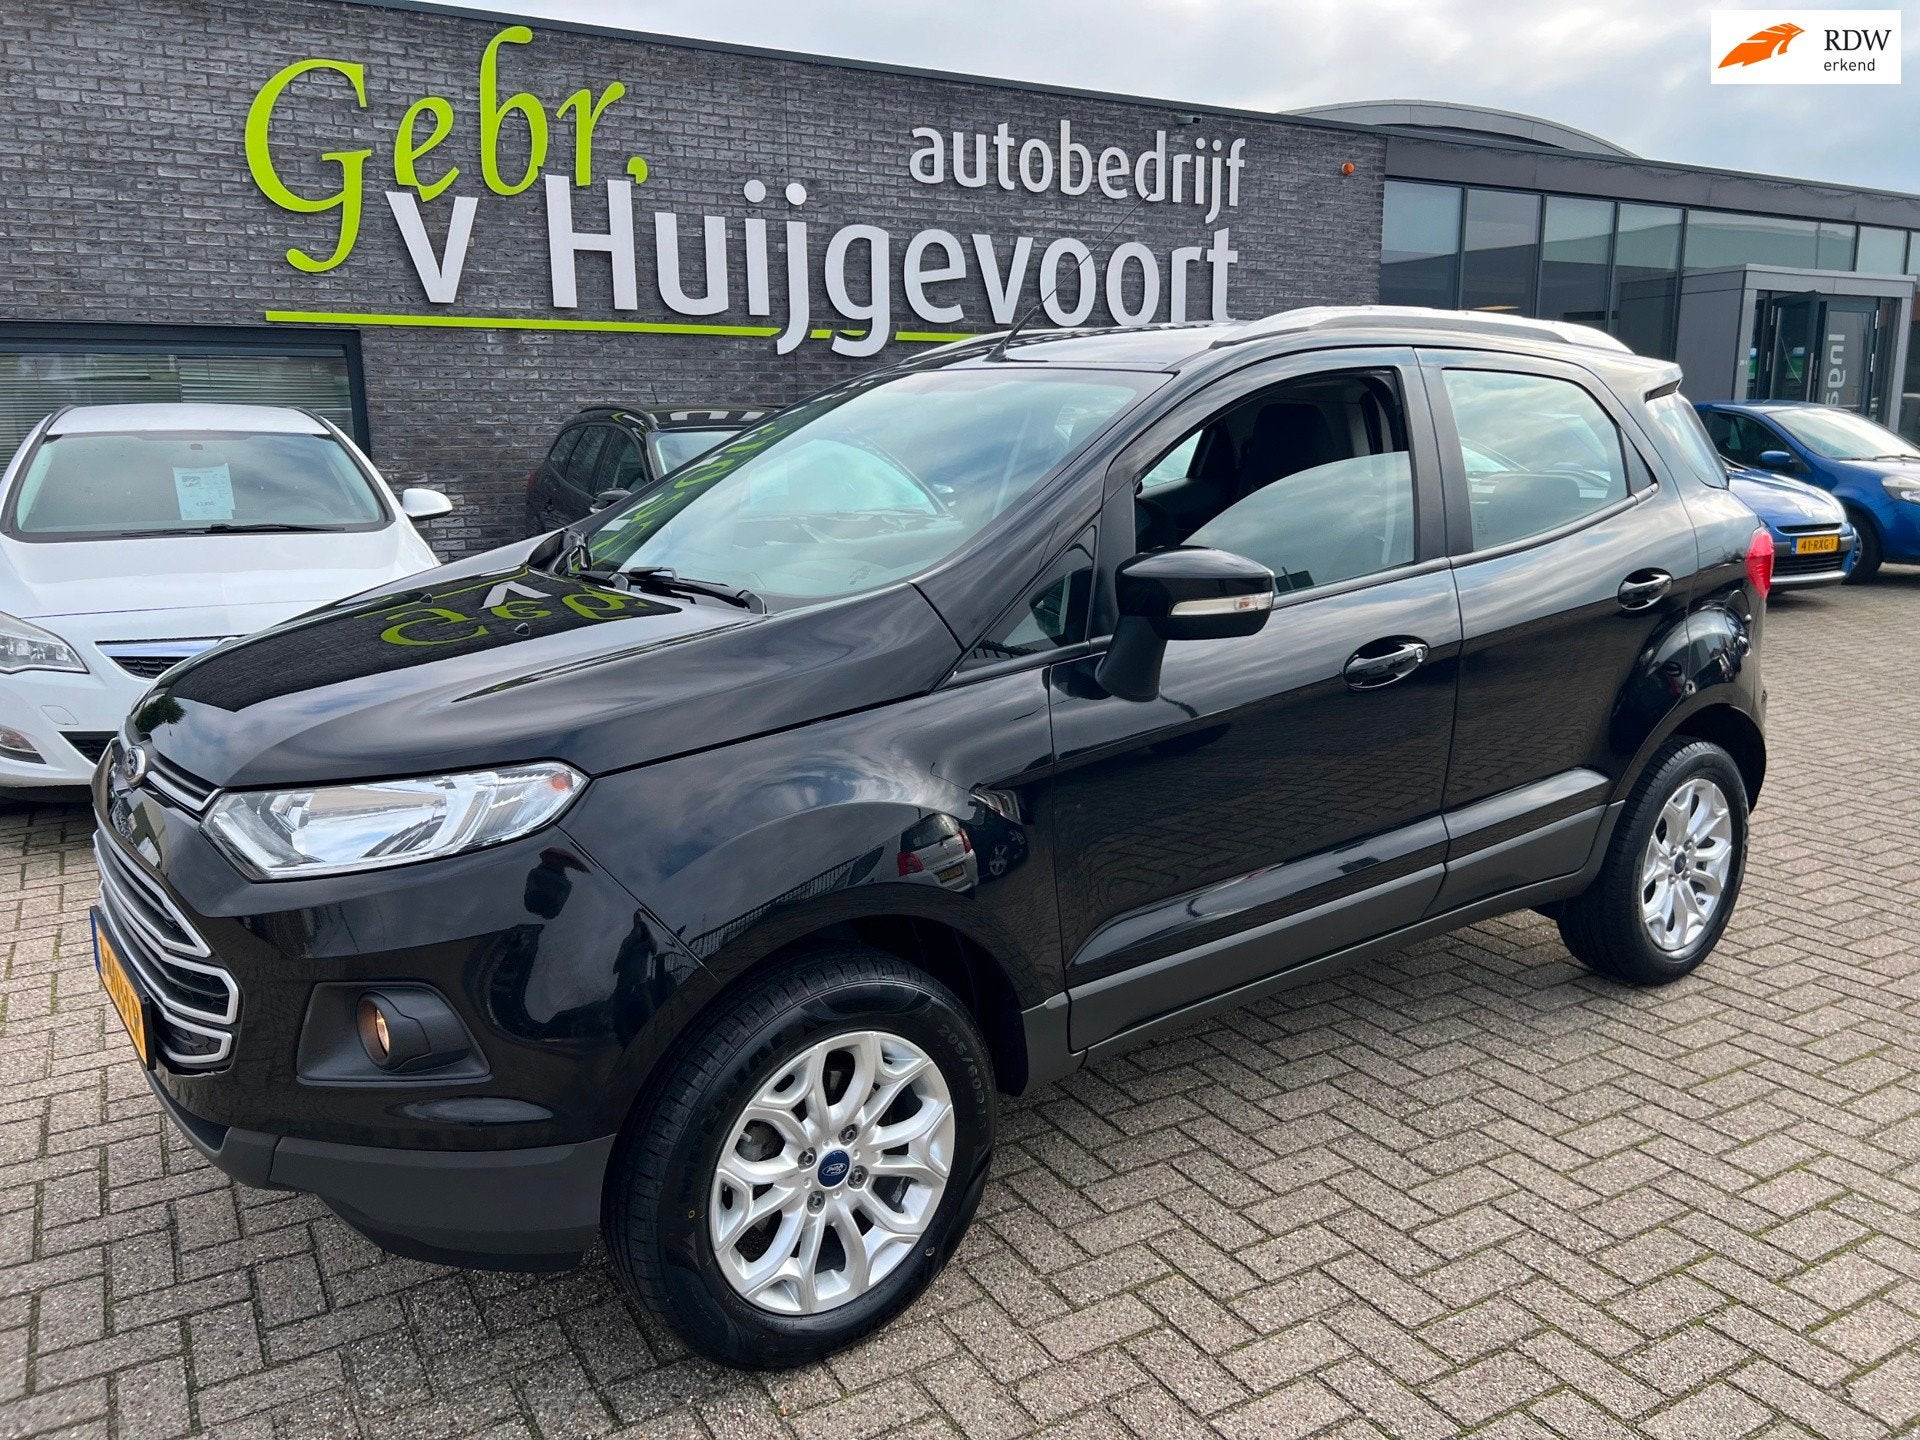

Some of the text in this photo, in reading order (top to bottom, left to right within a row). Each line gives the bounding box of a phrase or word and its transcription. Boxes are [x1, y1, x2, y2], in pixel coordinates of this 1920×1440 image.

[245, 26, 648, 272] Gebr.
[909, 120, 1245, 224] autobedrijf
[385, 175, 1238, 357] v Huijgevoort
[1801, 538, 1835, 552] 41-RXG-1
